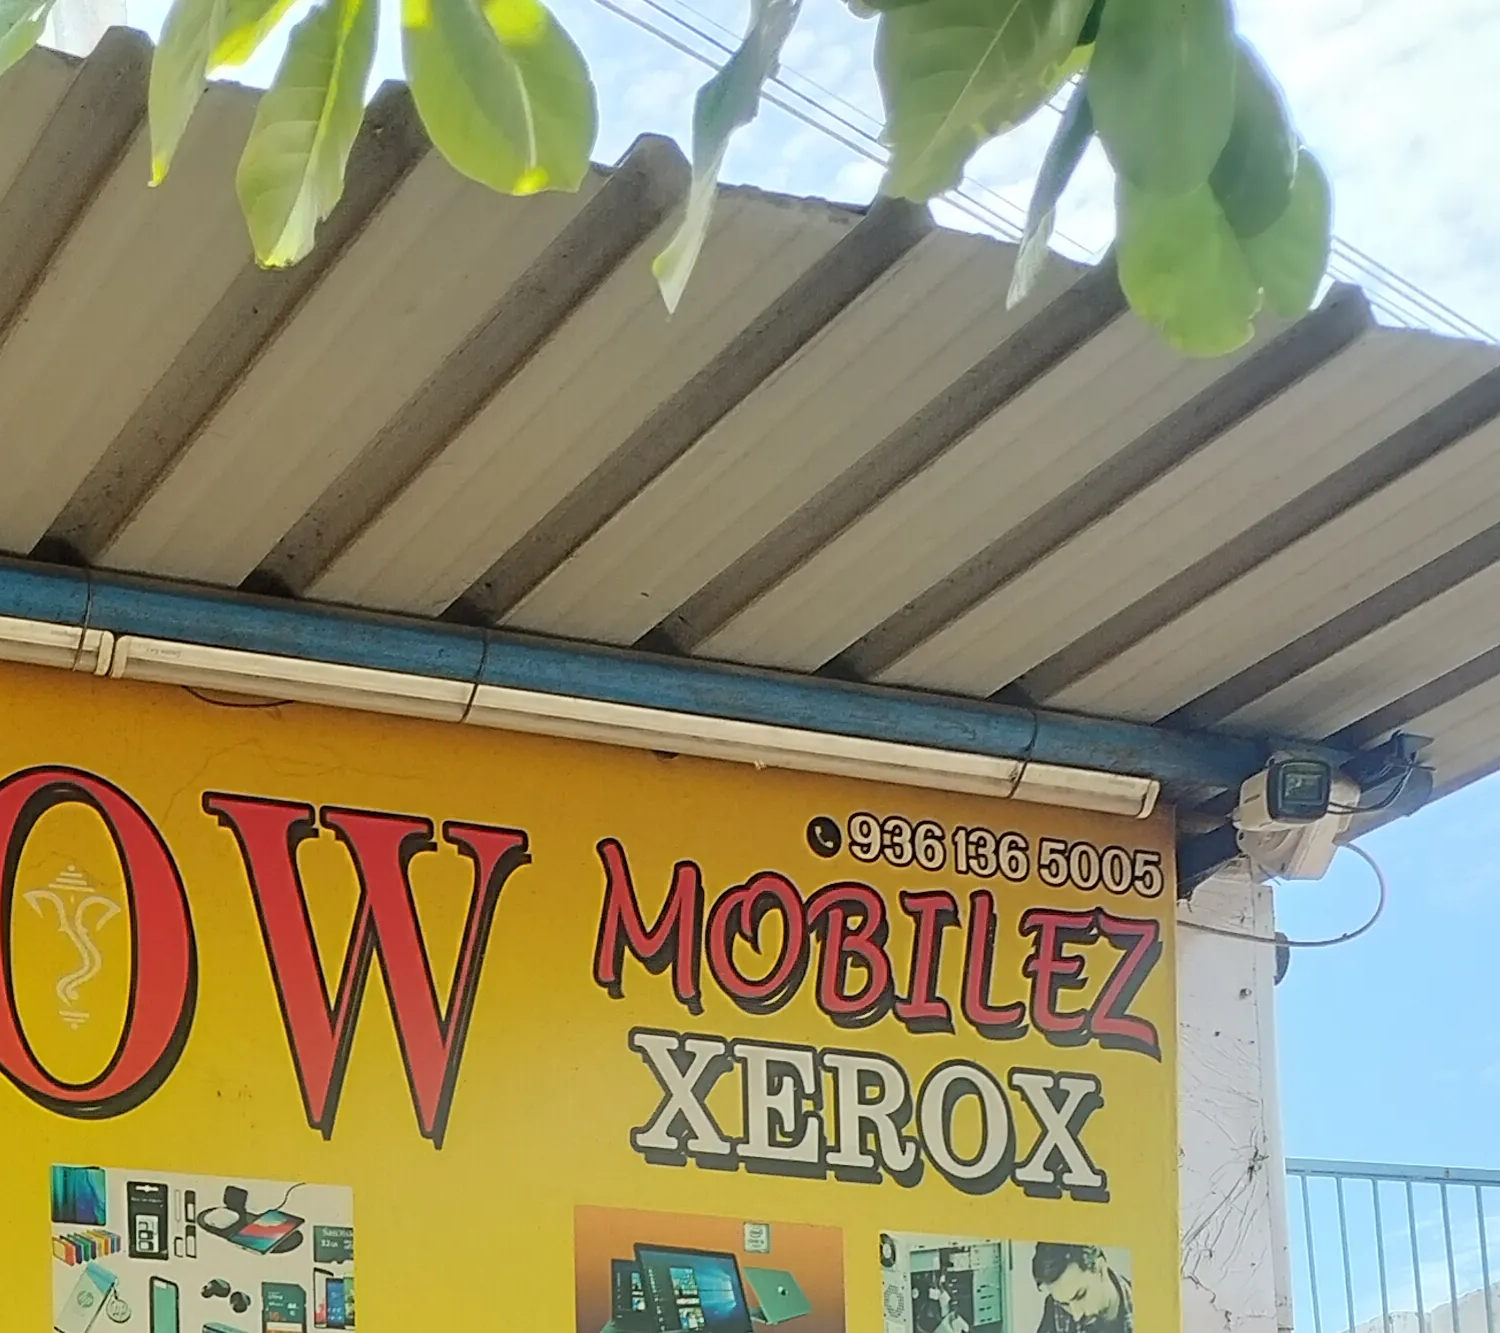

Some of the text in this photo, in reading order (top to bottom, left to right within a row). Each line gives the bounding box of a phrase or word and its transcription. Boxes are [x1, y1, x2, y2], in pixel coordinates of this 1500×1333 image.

[848, 812, 1164, 898] 936 136 5005
[594, 838, 1163, 1060] MOBILEZ
[630, 1028, 1111, 1201] XEROX
